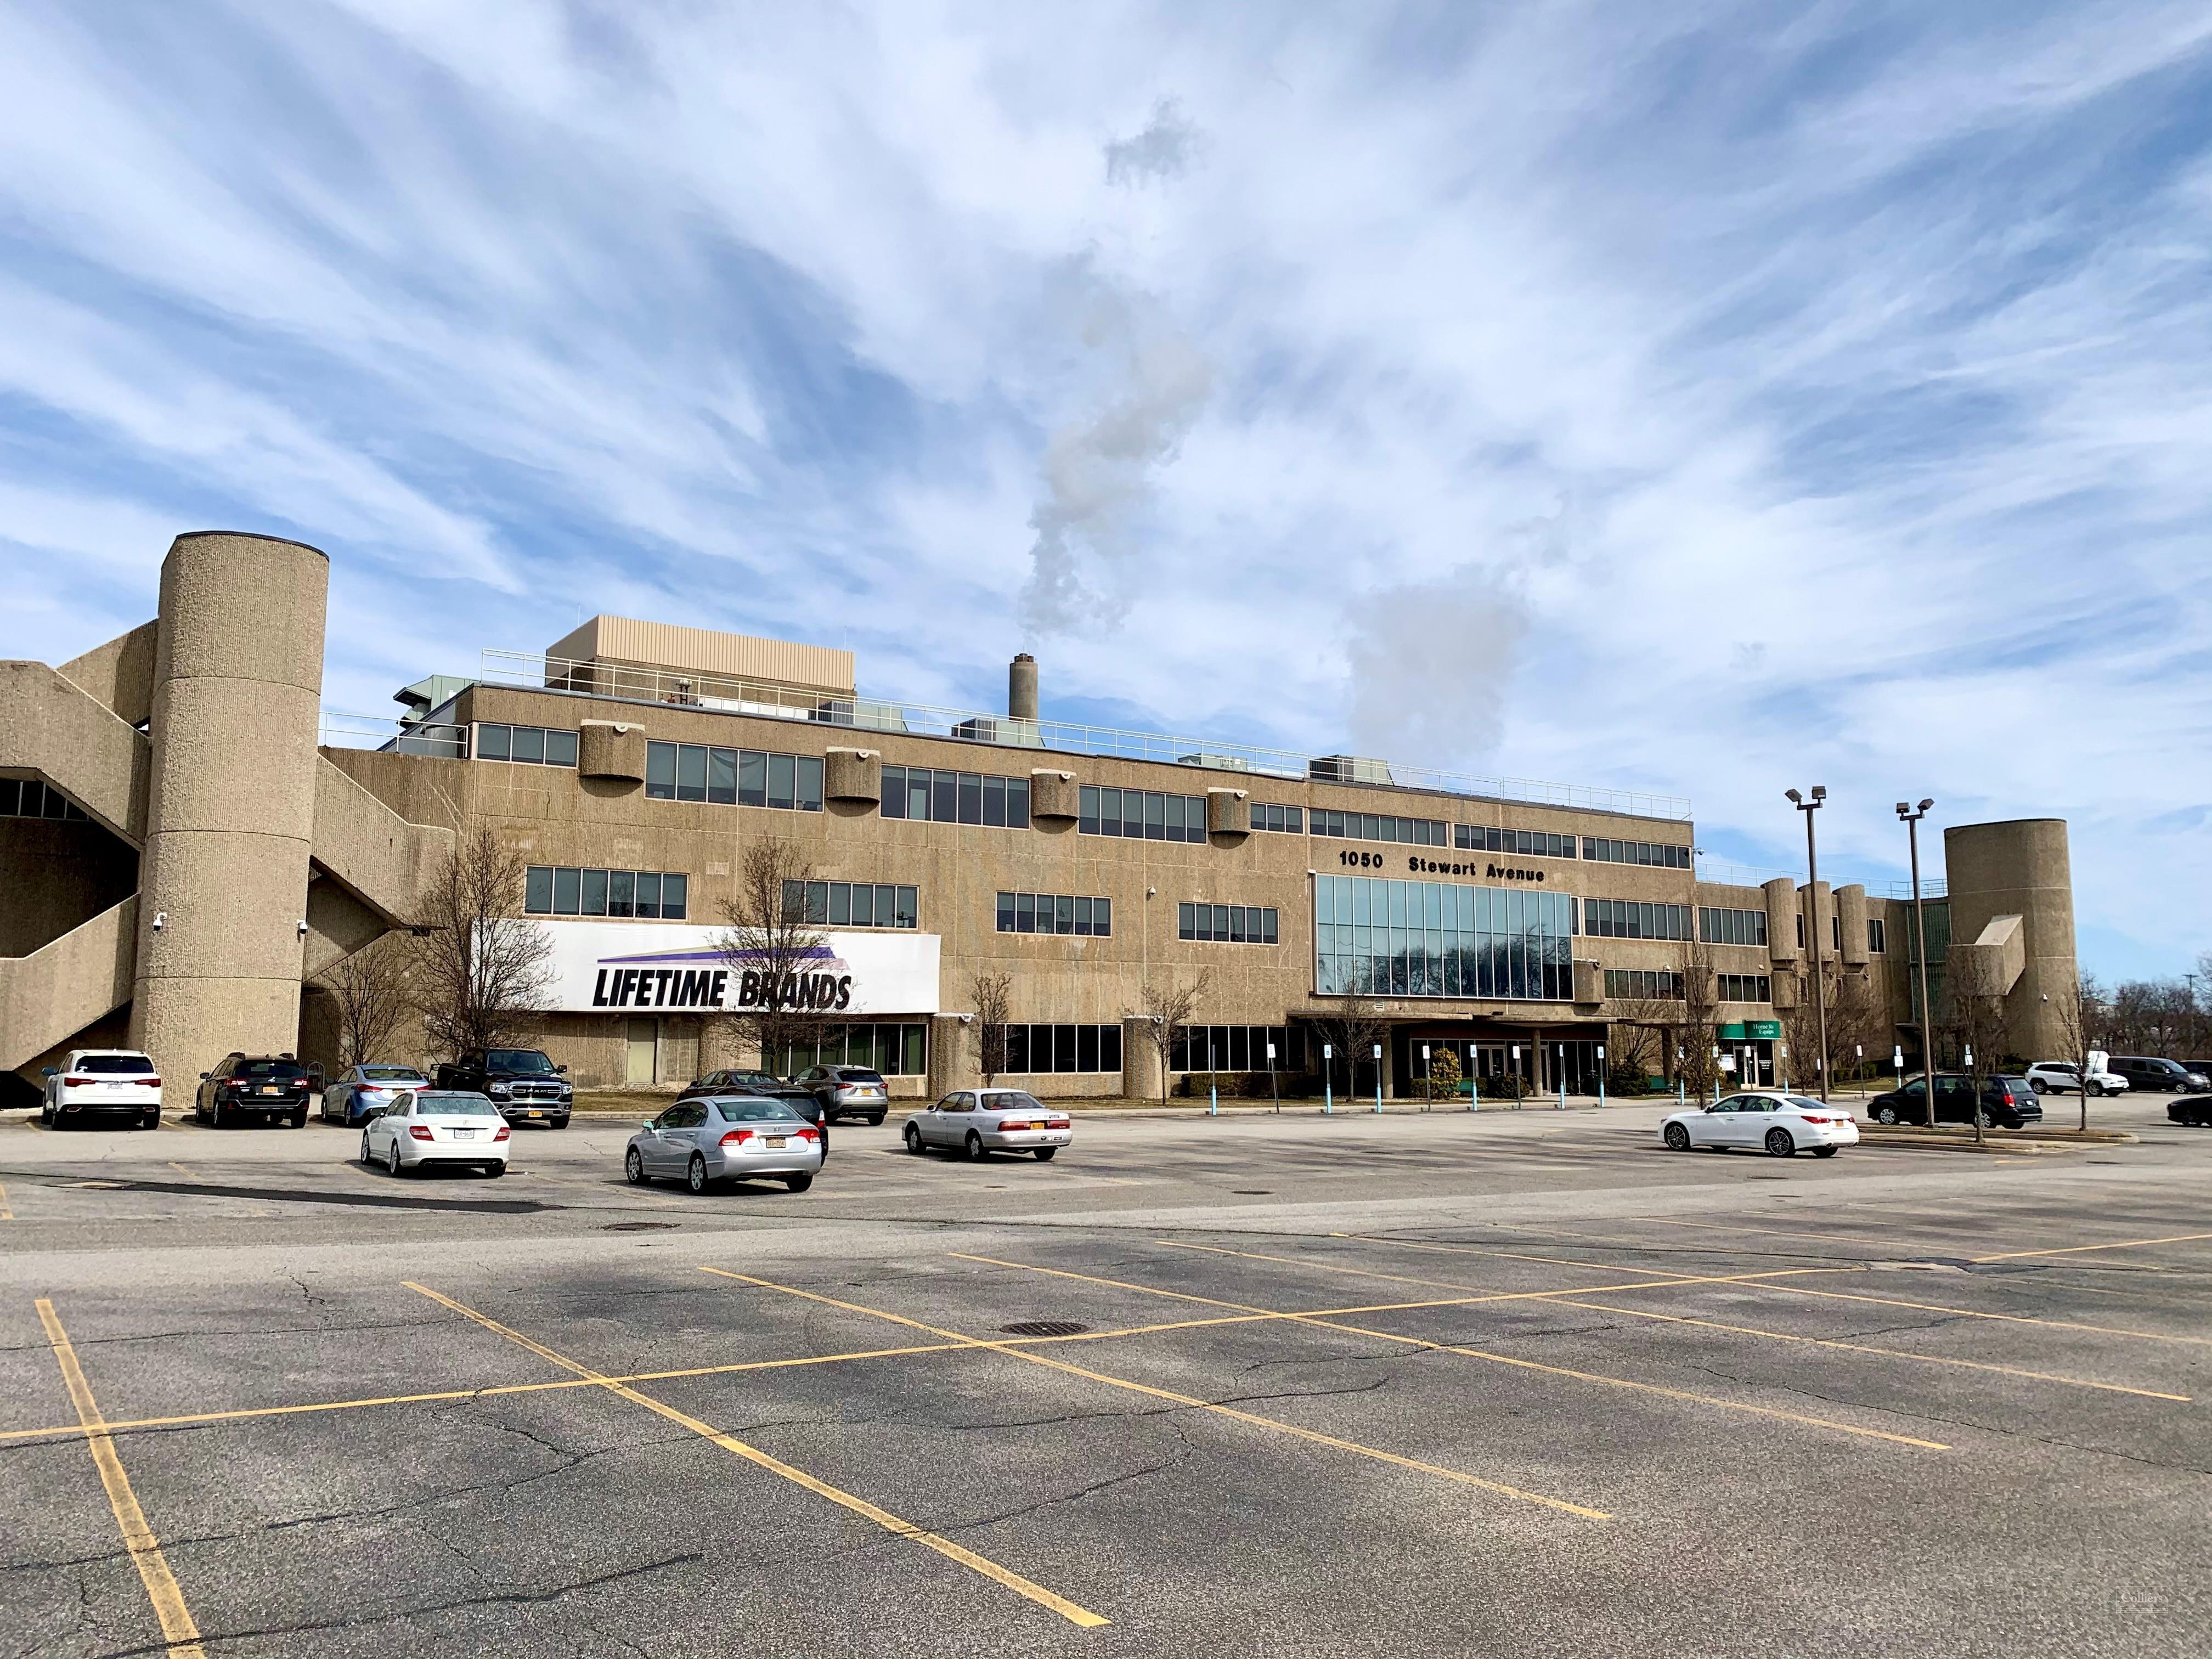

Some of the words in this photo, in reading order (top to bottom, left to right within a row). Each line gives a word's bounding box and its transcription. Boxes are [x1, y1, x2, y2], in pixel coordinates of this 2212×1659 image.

[1340, 851, 1383, 868] 1050
[1409, 856, 1476, 876] Stewart
[1486, 864, 1544, 882] Avenue
[592, 969, 728, 1007] LIFETIME
[738, 970, 851, 1009] BRANDS
